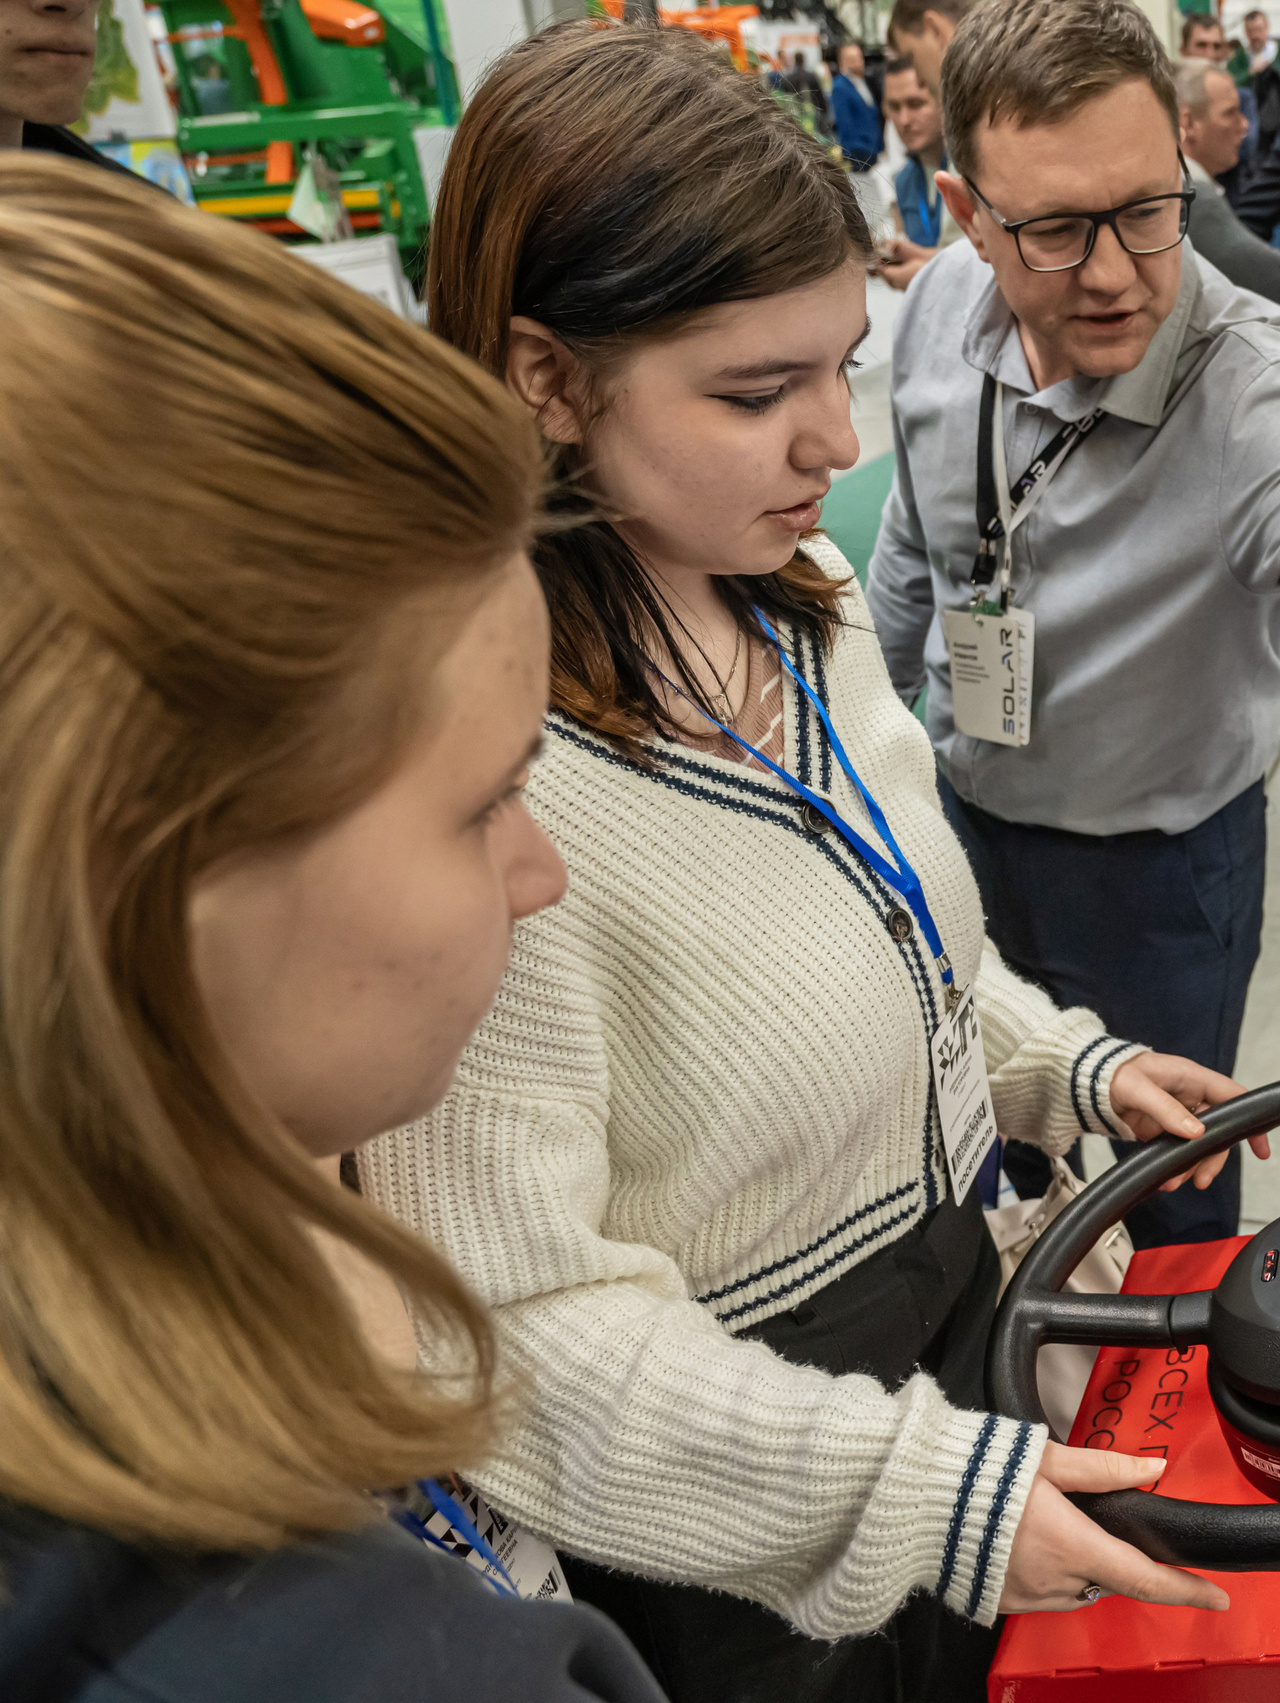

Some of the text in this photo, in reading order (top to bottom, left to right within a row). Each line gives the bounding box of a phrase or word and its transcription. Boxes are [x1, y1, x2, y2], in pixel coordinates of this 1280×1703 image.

[1001, 628, 1015, 735] SOLAR
[958, 1124, 994, 1192] посетитель
[1085, 1359, 1140, 1448] РОСС
[1144, 1346, 1196, 1433] ВСЕХ
